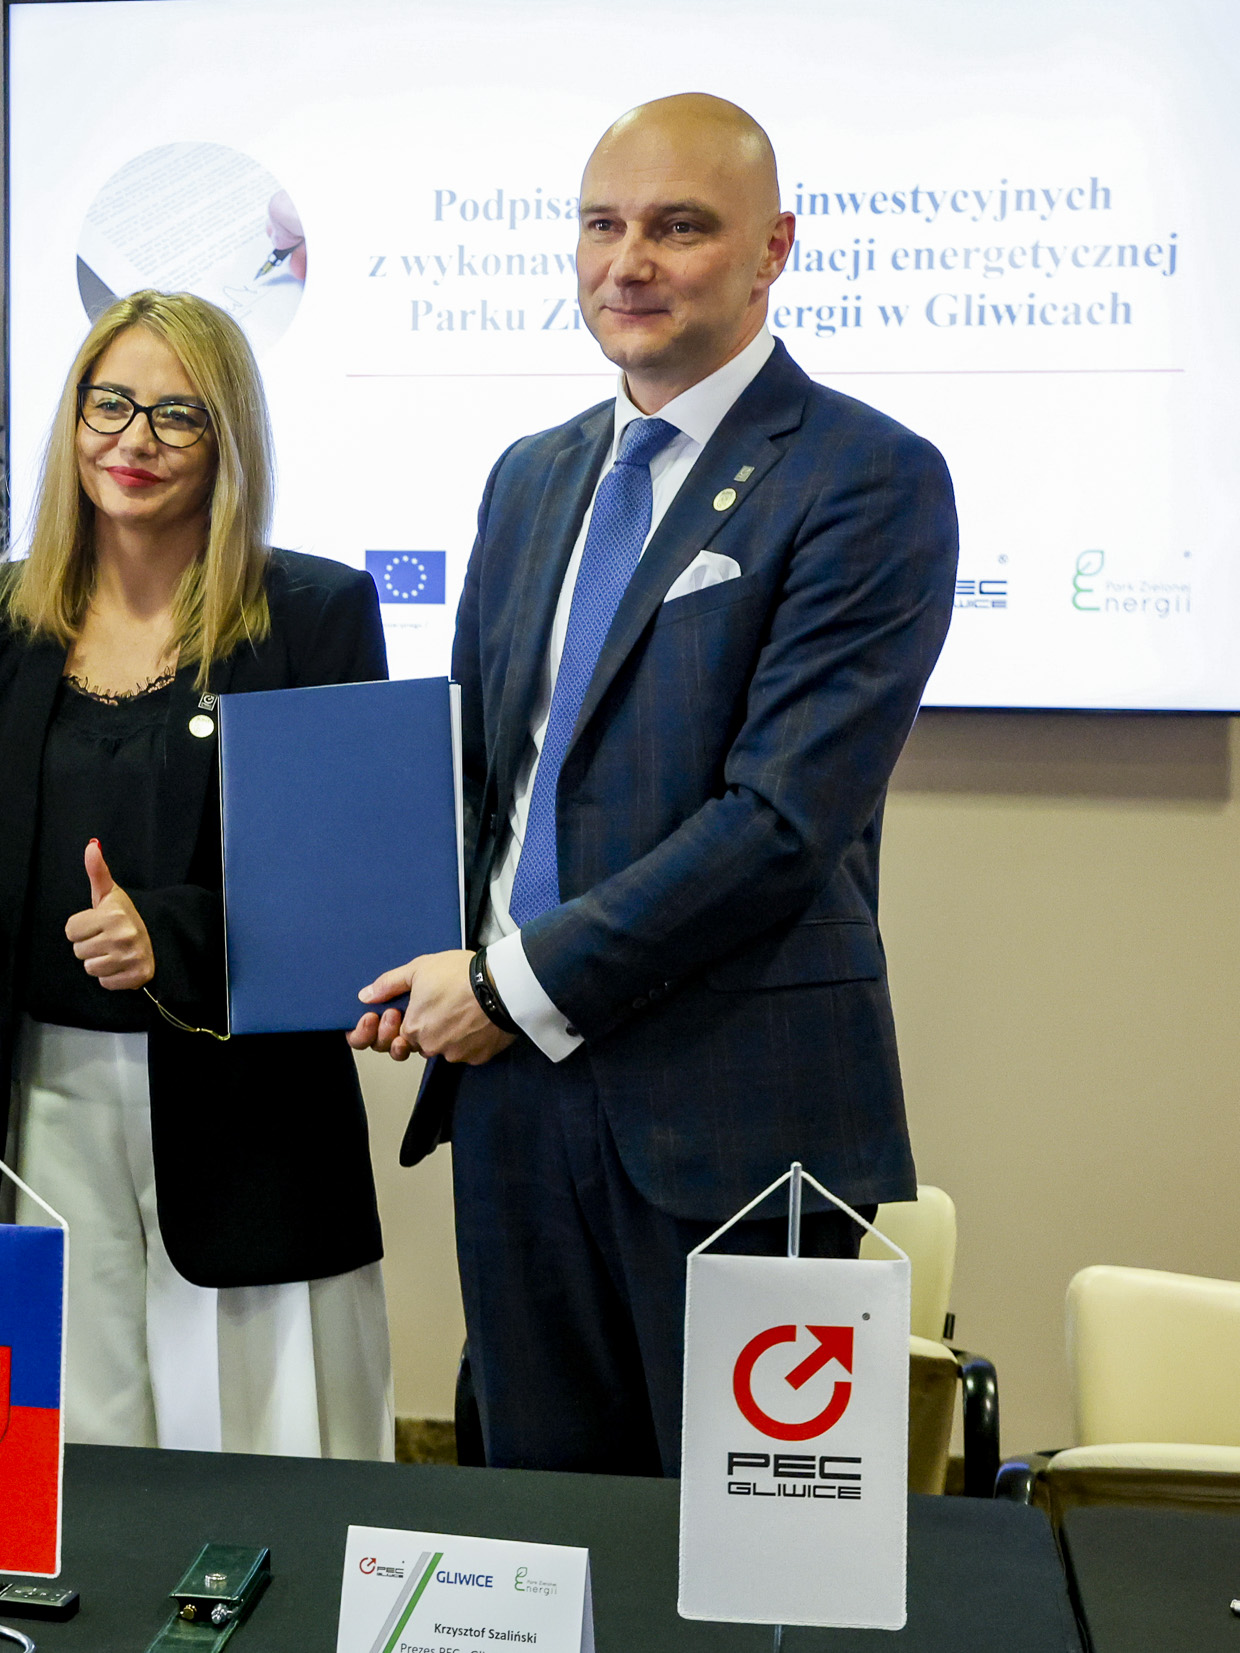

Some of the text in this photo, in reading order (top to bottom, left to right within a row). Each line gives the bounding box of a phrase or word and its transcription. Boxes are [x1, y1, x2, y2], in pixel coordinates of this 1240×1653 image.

[432, 176, 1113, 230] Podpisa inwestycyjnych
[368, 232, 1180, 286] z wykonaw lacji energetycznej
[409, 299, 527, 333] Parku
[772, 295, 863, 338] ergii
[876, 303, 911, 328] w
[924, 291, 1133, 328] Gliwicach
[955, 579, 1008, 595] EC
[727, 1451, 862, 1482] PEC
[727, 1480, 862, 1501] GLIWICE
[436, 1570, 494, 1588] GLIWICE
[433, 1623, 538, 1644] Krzysztof Szaliński
